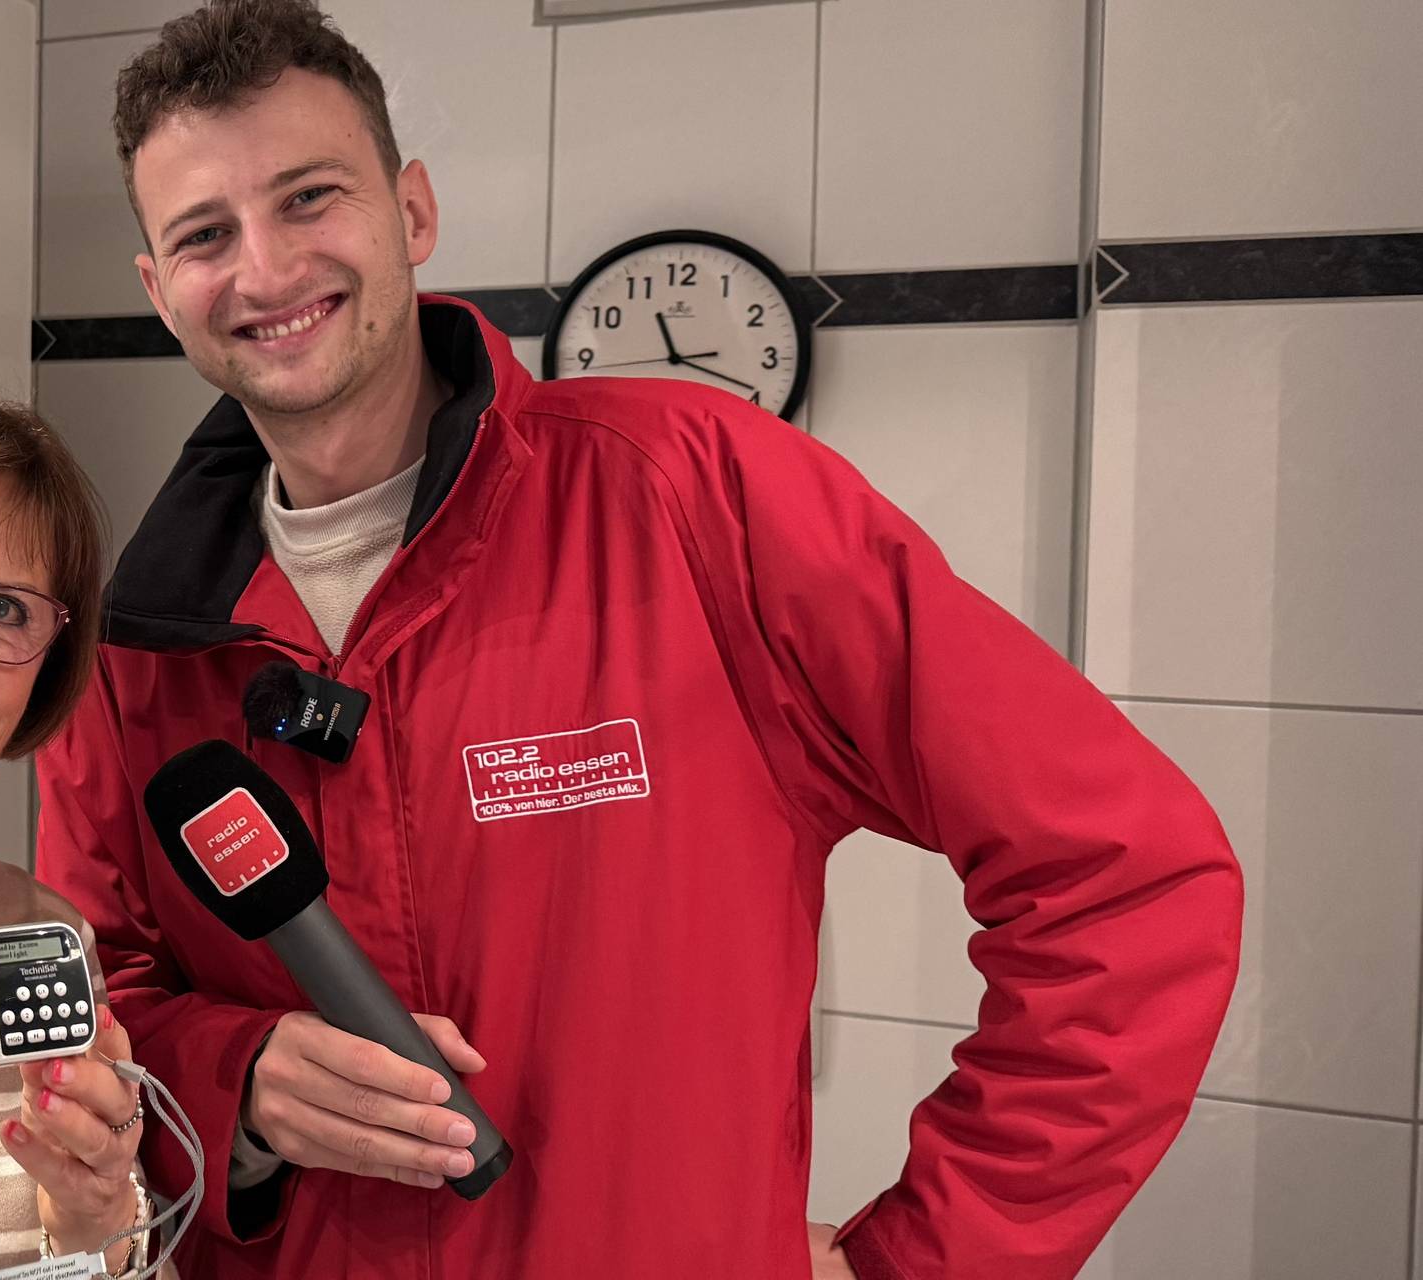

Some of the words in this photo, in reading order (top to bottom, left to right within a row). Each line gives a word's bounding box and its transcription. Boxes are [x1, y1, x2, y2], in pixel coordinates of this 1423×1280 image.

[666, 263, 697, 286] 12
[627, 277, 652, 299] 11
[721, 275, 730, 298] 1
[592, 306, 621, 329] 10
[747, 304, 764, 327] 2
[578, 349, 594, 370] 9
[761, 347, 778, 369] 3
[490, 762, 555, 785] radio
[558, 751, 630, 776] essen
[479, 804, 513, 816] 100%
[514, 801, 535, 811] von
[535, 798, 560, 808] hier.
[562, 793, 583, 805] Der
[583, 787, 616, 801] beste
[617, 782, 642, 795] Mix.
[207, 816, 248, 848] radio
[213, 827, 261, 863] essen
[19, 963, 57, 975] TechniSat
